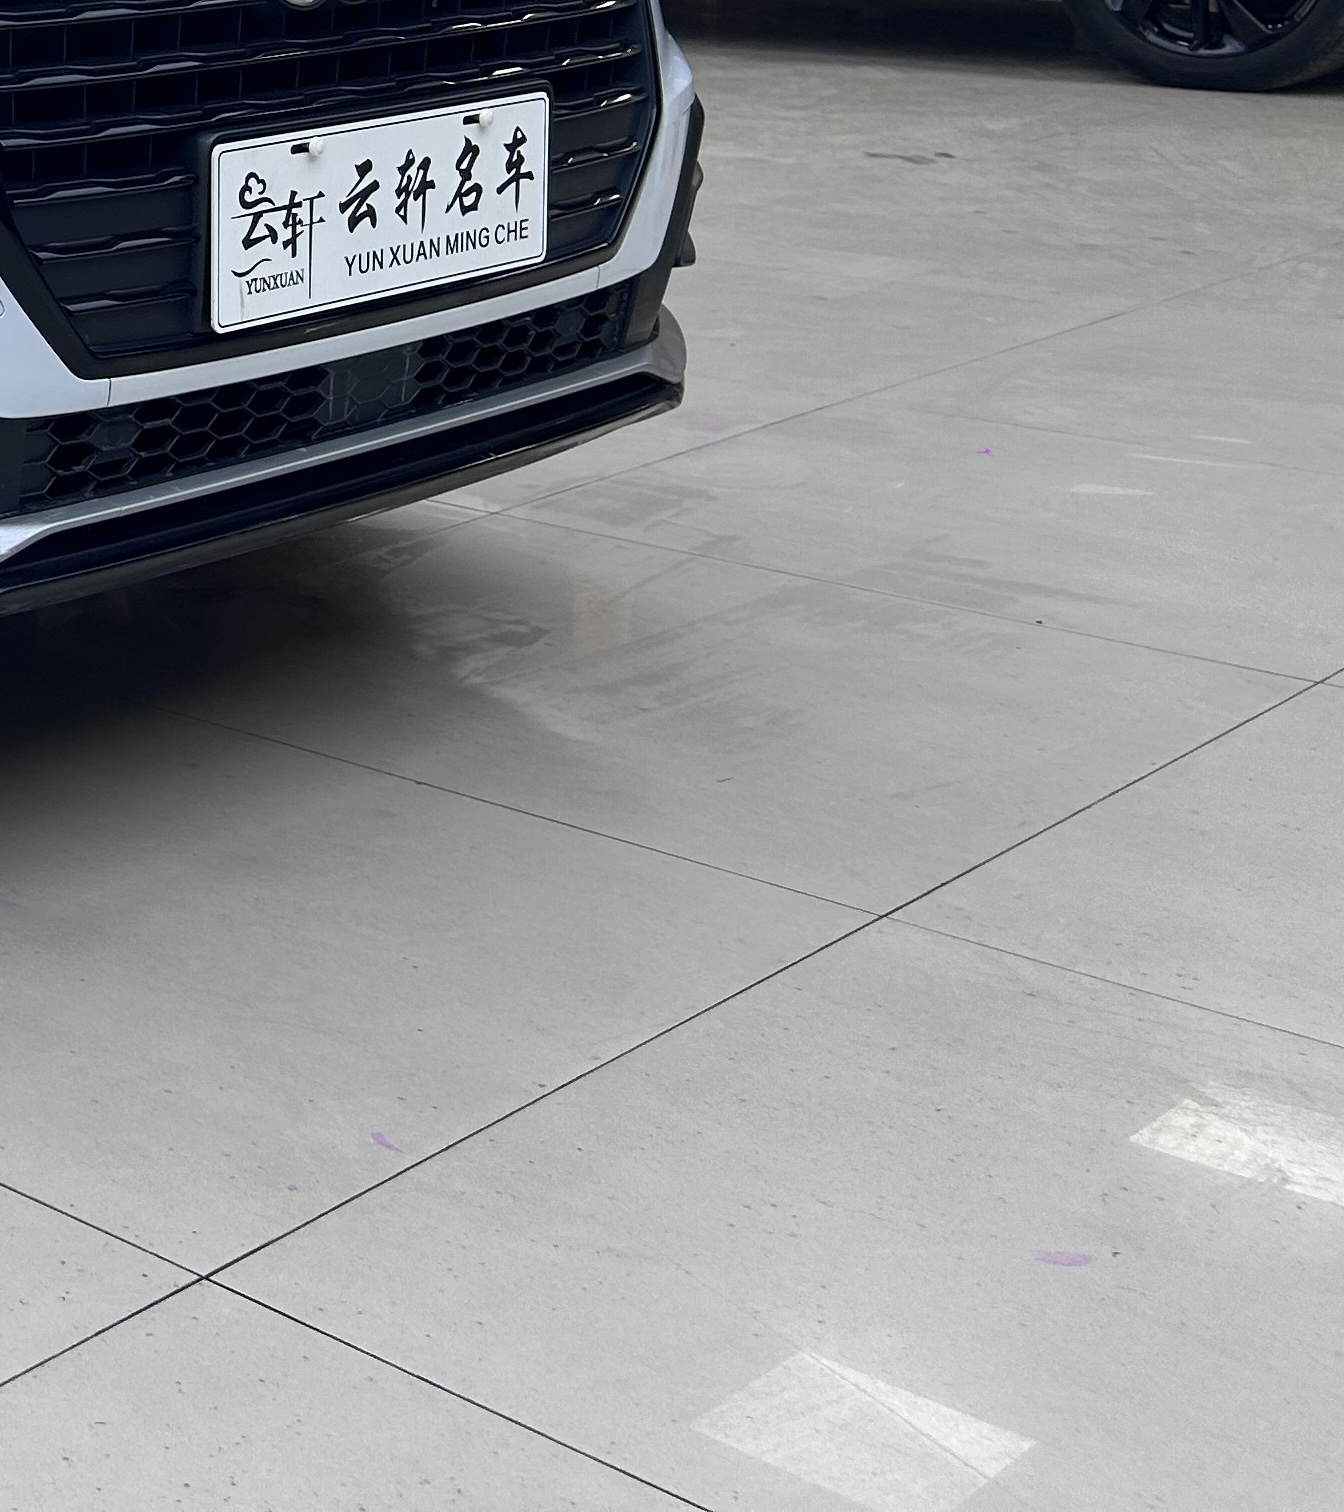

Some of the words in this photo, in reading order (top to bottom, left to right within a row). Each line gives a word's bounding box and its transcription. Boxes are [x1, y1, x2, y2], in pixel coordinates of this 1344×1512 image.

[339, 125, 535, 234] 云轩名车
[343, 248, 384, 277] YUN
[388, 236, 441, 269] XUAN
[445, 226, 491, 256] MING
[494, 218, 530, 246] CHE
[245, 268, 305, 295] YUNXUAN
